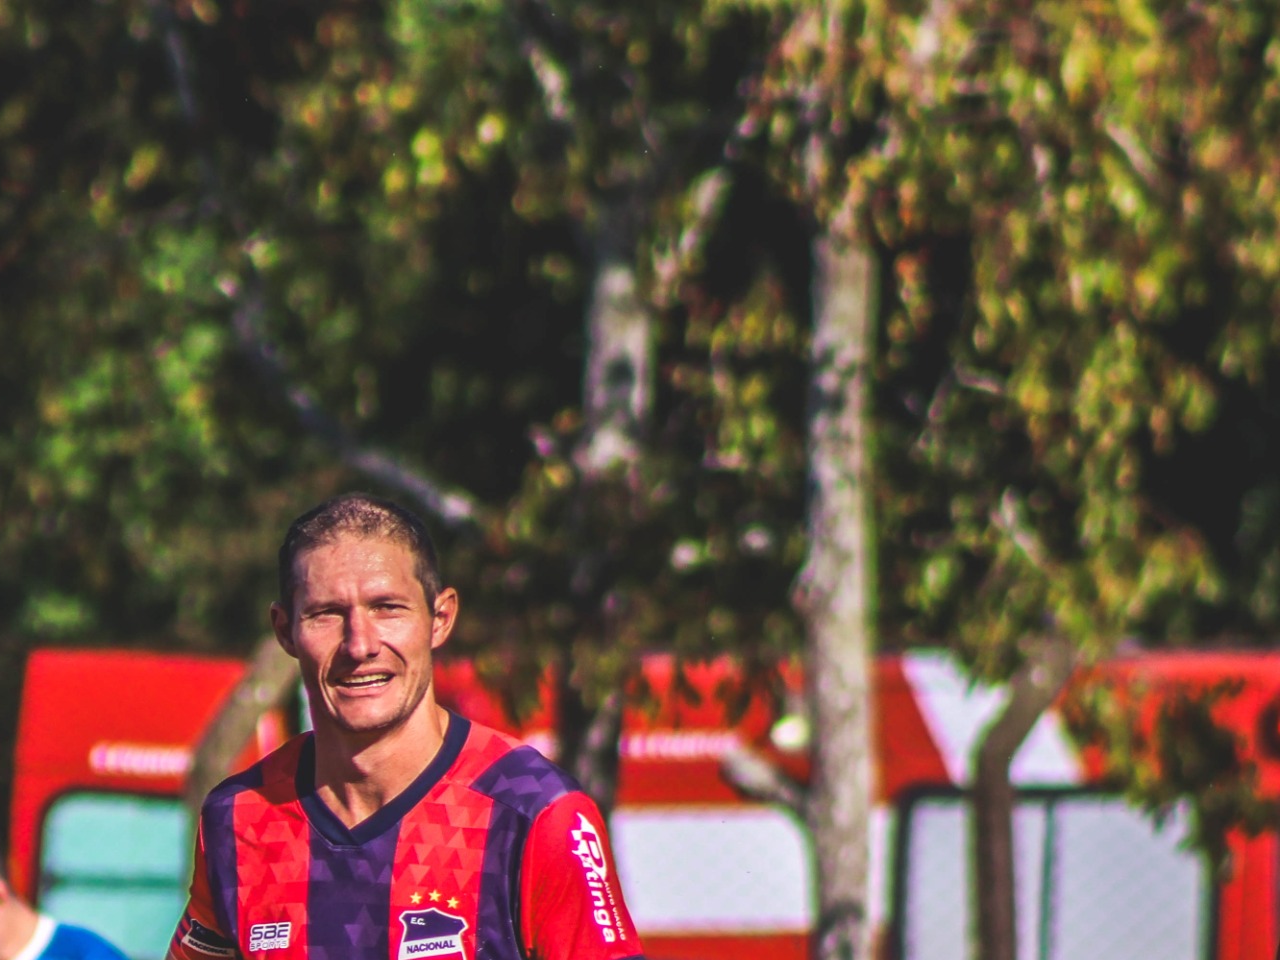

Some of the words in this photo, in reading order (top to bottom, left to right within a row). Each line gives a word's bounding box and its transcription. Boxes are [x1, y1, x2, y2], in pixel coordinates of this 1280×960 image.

[250, 922, 291, 941] SBE
[250, 940, 289, 951] SPORTS
[407, 940, 456, 954] NACIONAL
